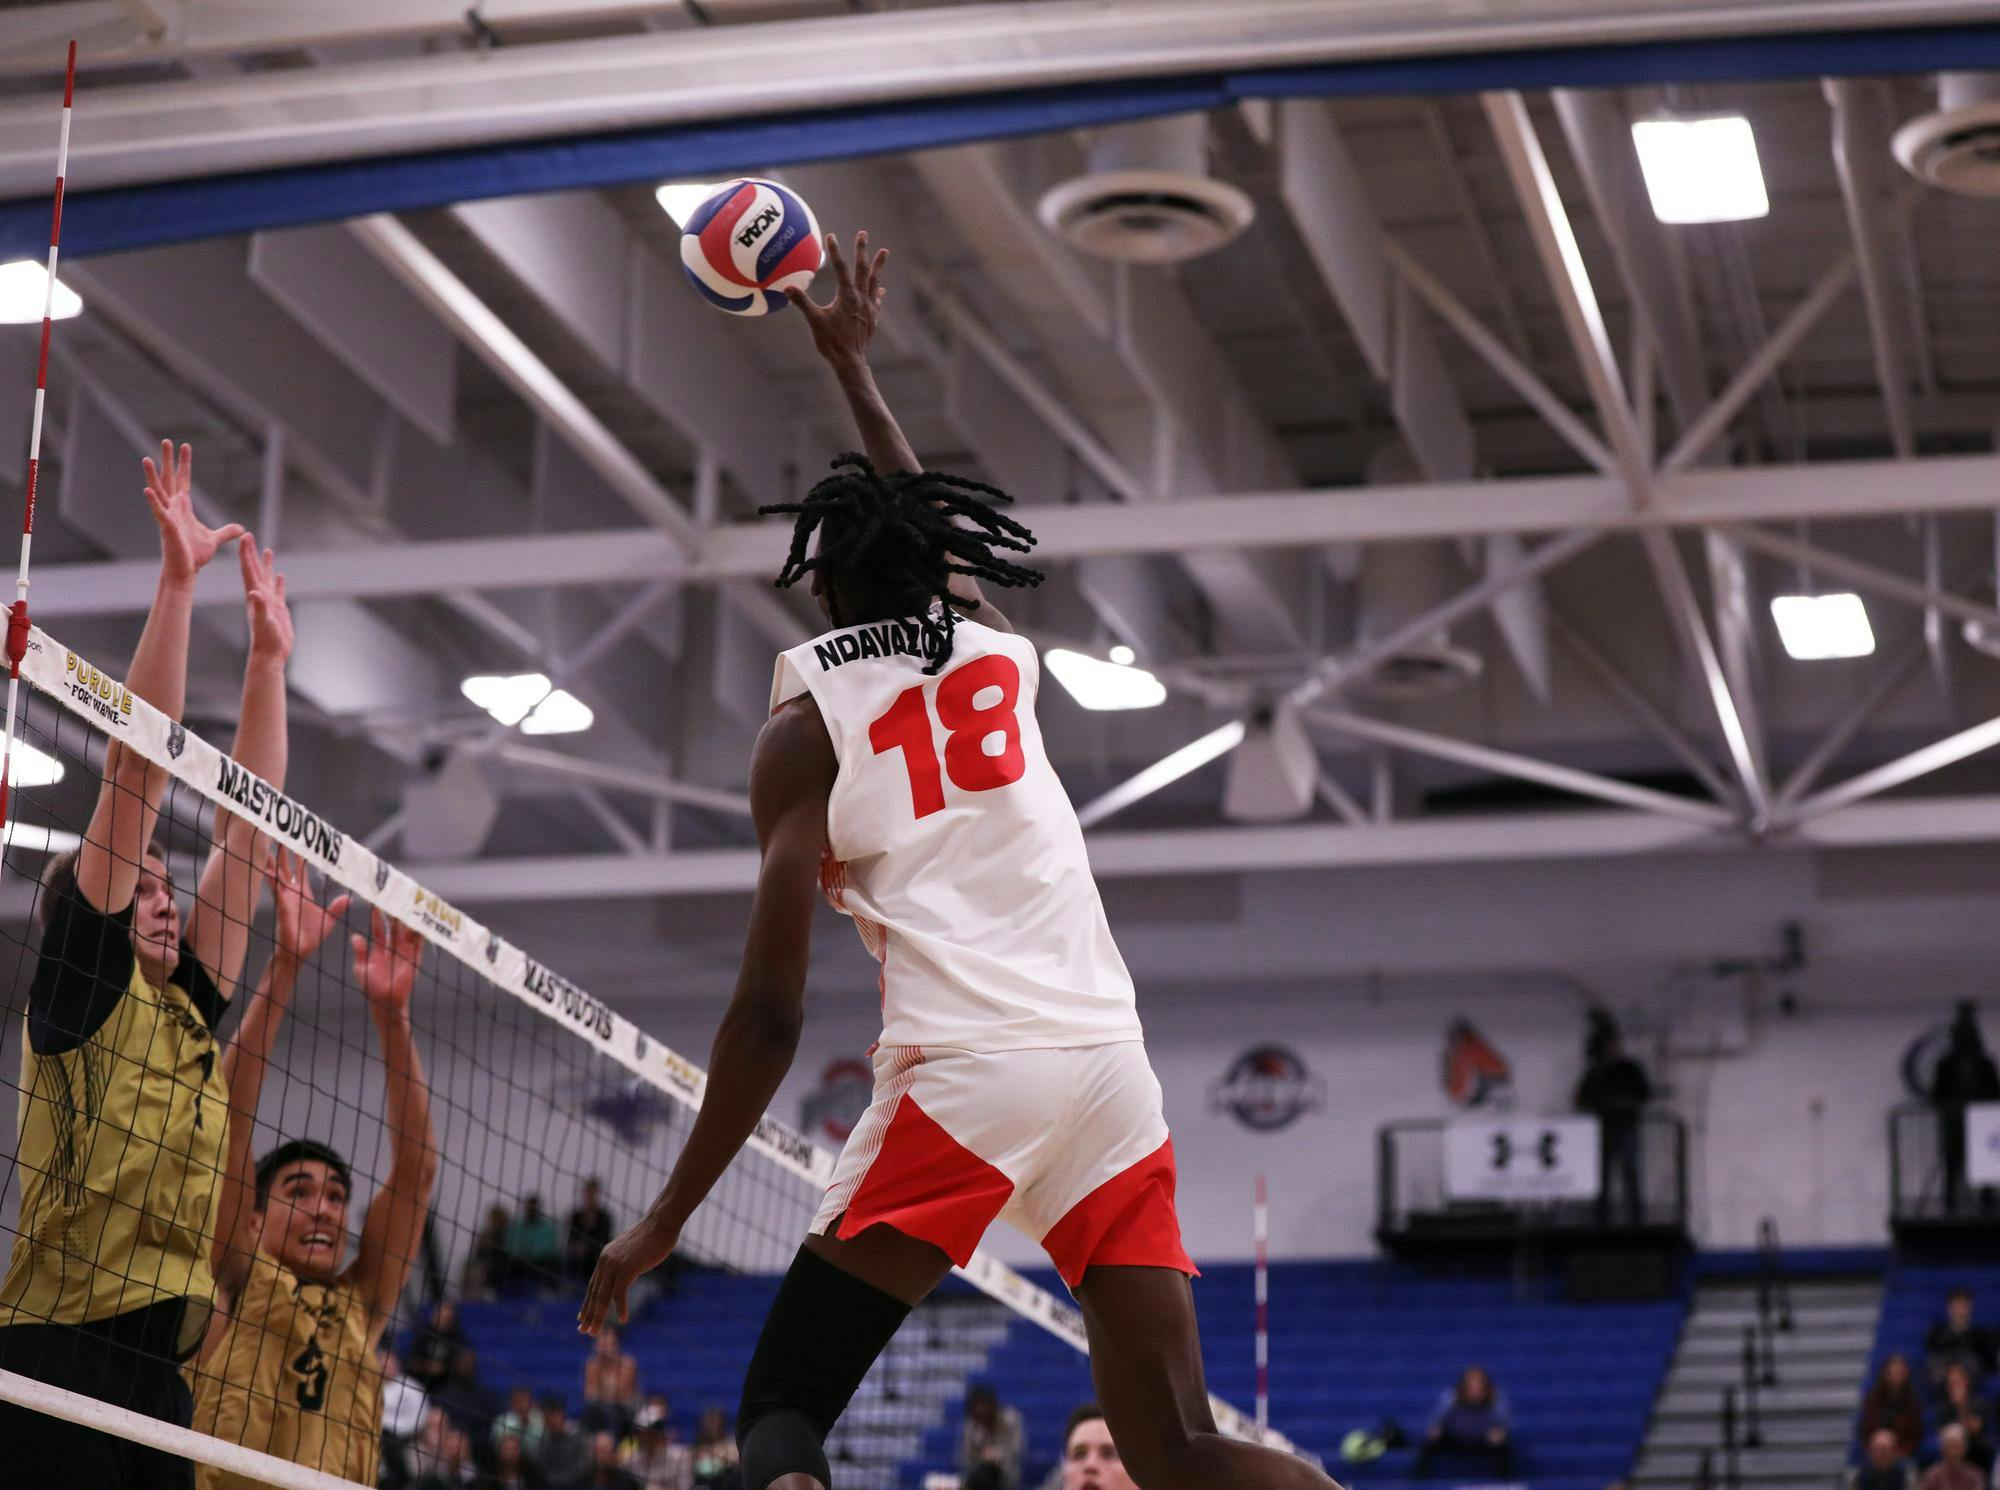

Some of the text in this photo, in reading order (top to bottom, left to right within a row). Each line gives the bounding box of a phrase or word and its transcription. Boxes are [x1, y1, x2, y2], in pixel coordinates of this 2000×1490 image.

[738, 204, 781, 248] NCAA
[868, 653, 1026, 821] 18
[216, 756, 344, 864] MASTODONS
